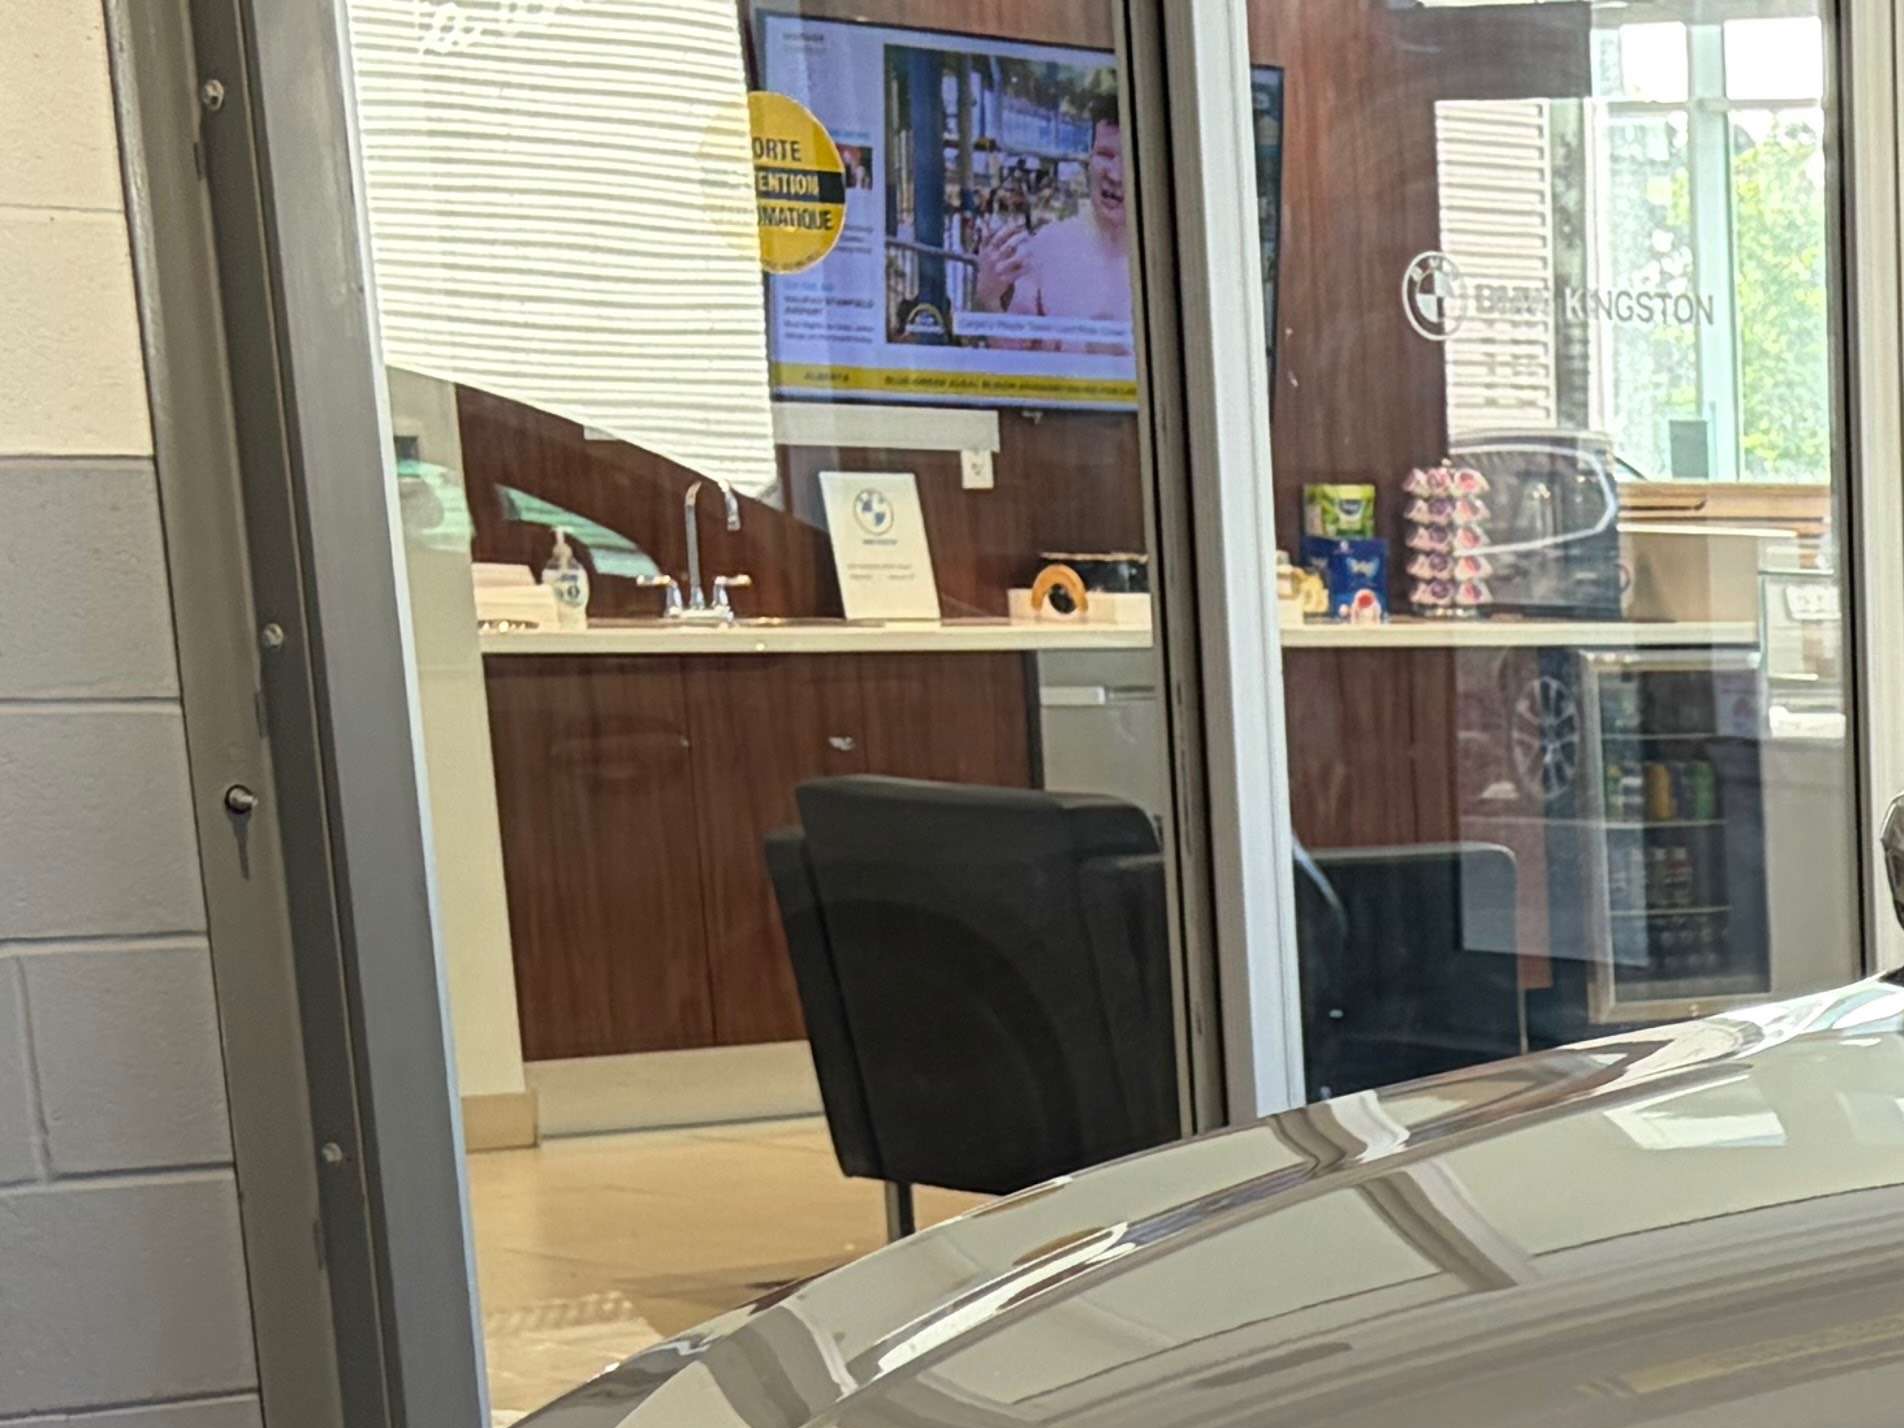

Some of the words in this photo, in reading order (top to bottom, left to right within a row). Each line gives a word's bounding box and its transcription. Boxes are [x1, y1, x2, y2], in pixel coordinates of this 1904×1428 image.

[752, 136, 803, 162] ORTE
[757, 171, 819, 195] ENTION
[759, 206, 834, 231] MATIQUE
[1564, 287, 1716, 326] KINGSTON
